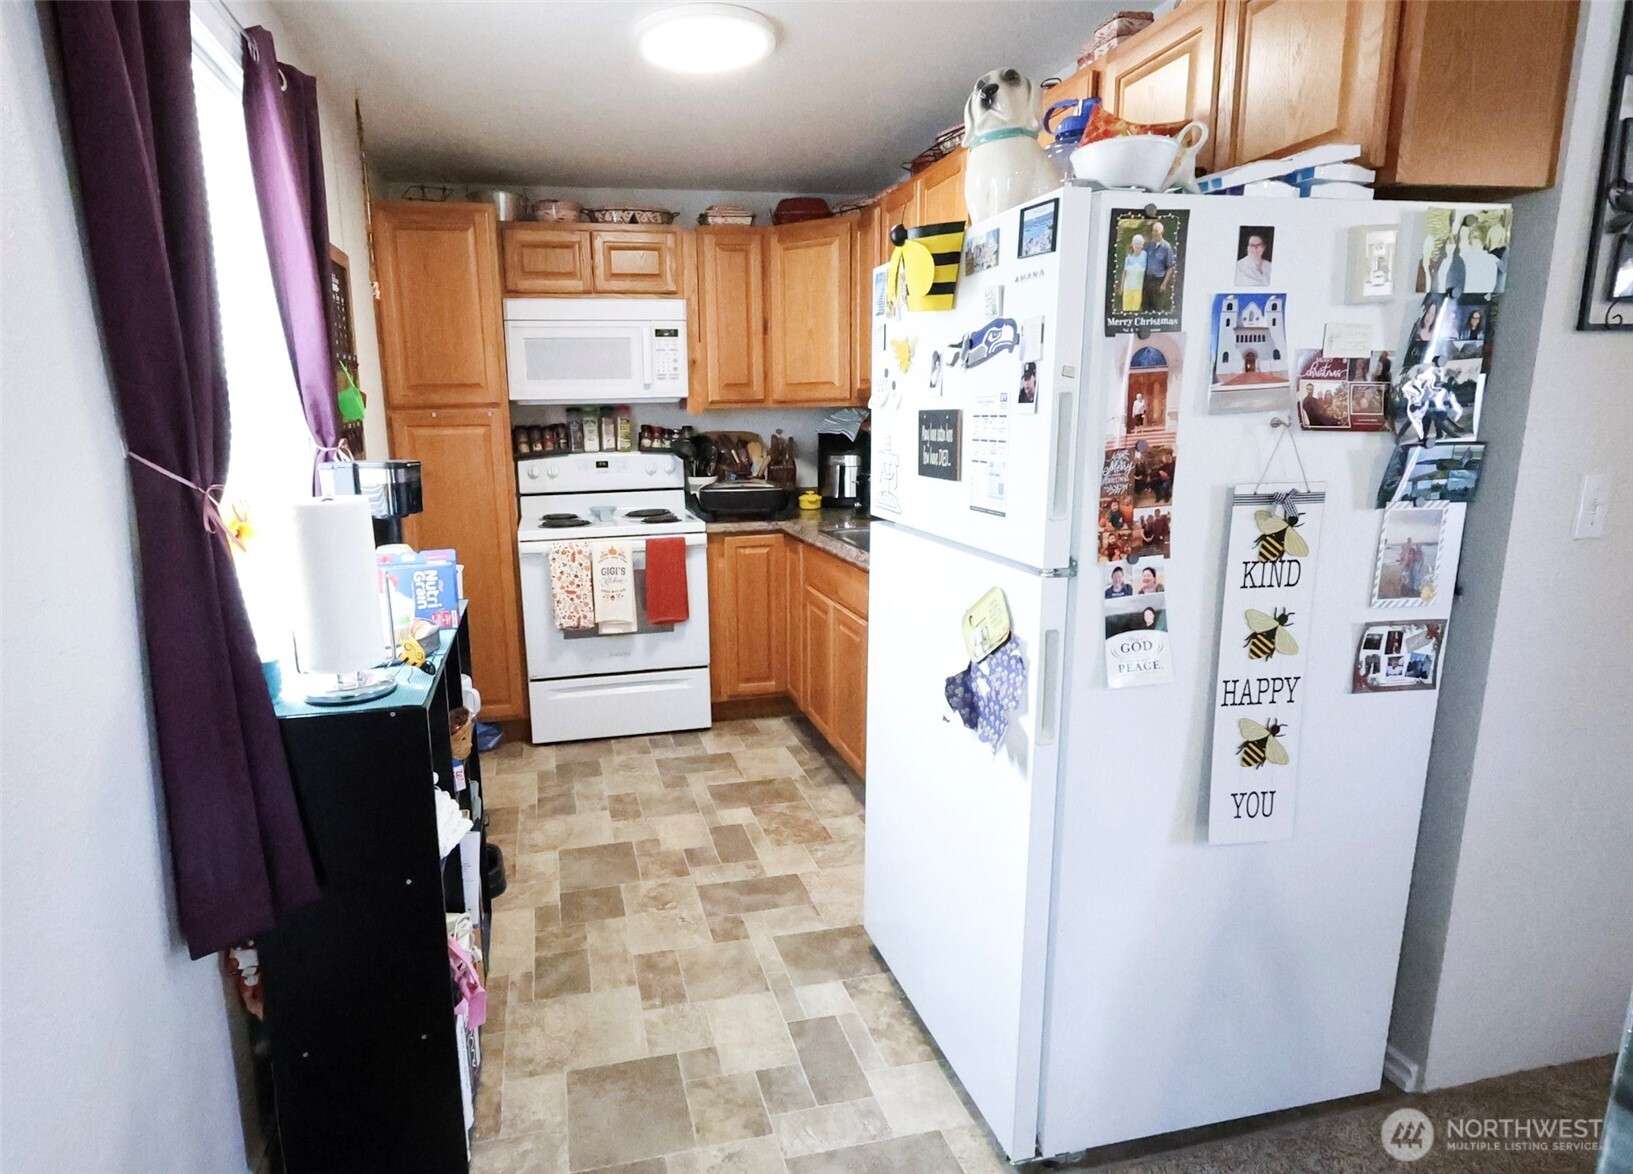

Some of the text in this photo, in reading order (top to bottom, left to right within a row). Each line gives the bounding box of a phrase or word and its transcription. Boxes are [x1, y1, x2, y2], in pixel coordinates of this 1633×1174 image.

[1107, 317, 1179, 327] Merry Christmas
[601, 566, 626, 576] GIGI'S
[1240, 559, 1302, 589] KIND
[413, 570, 428, 610] Grain
[424, 570, 442, 608] Nutri
[1120, 640, 1153, 654] GOD
[1220, 676, 1301, 707] HAPPY
[1230, 790, 1276, 819] YOU
